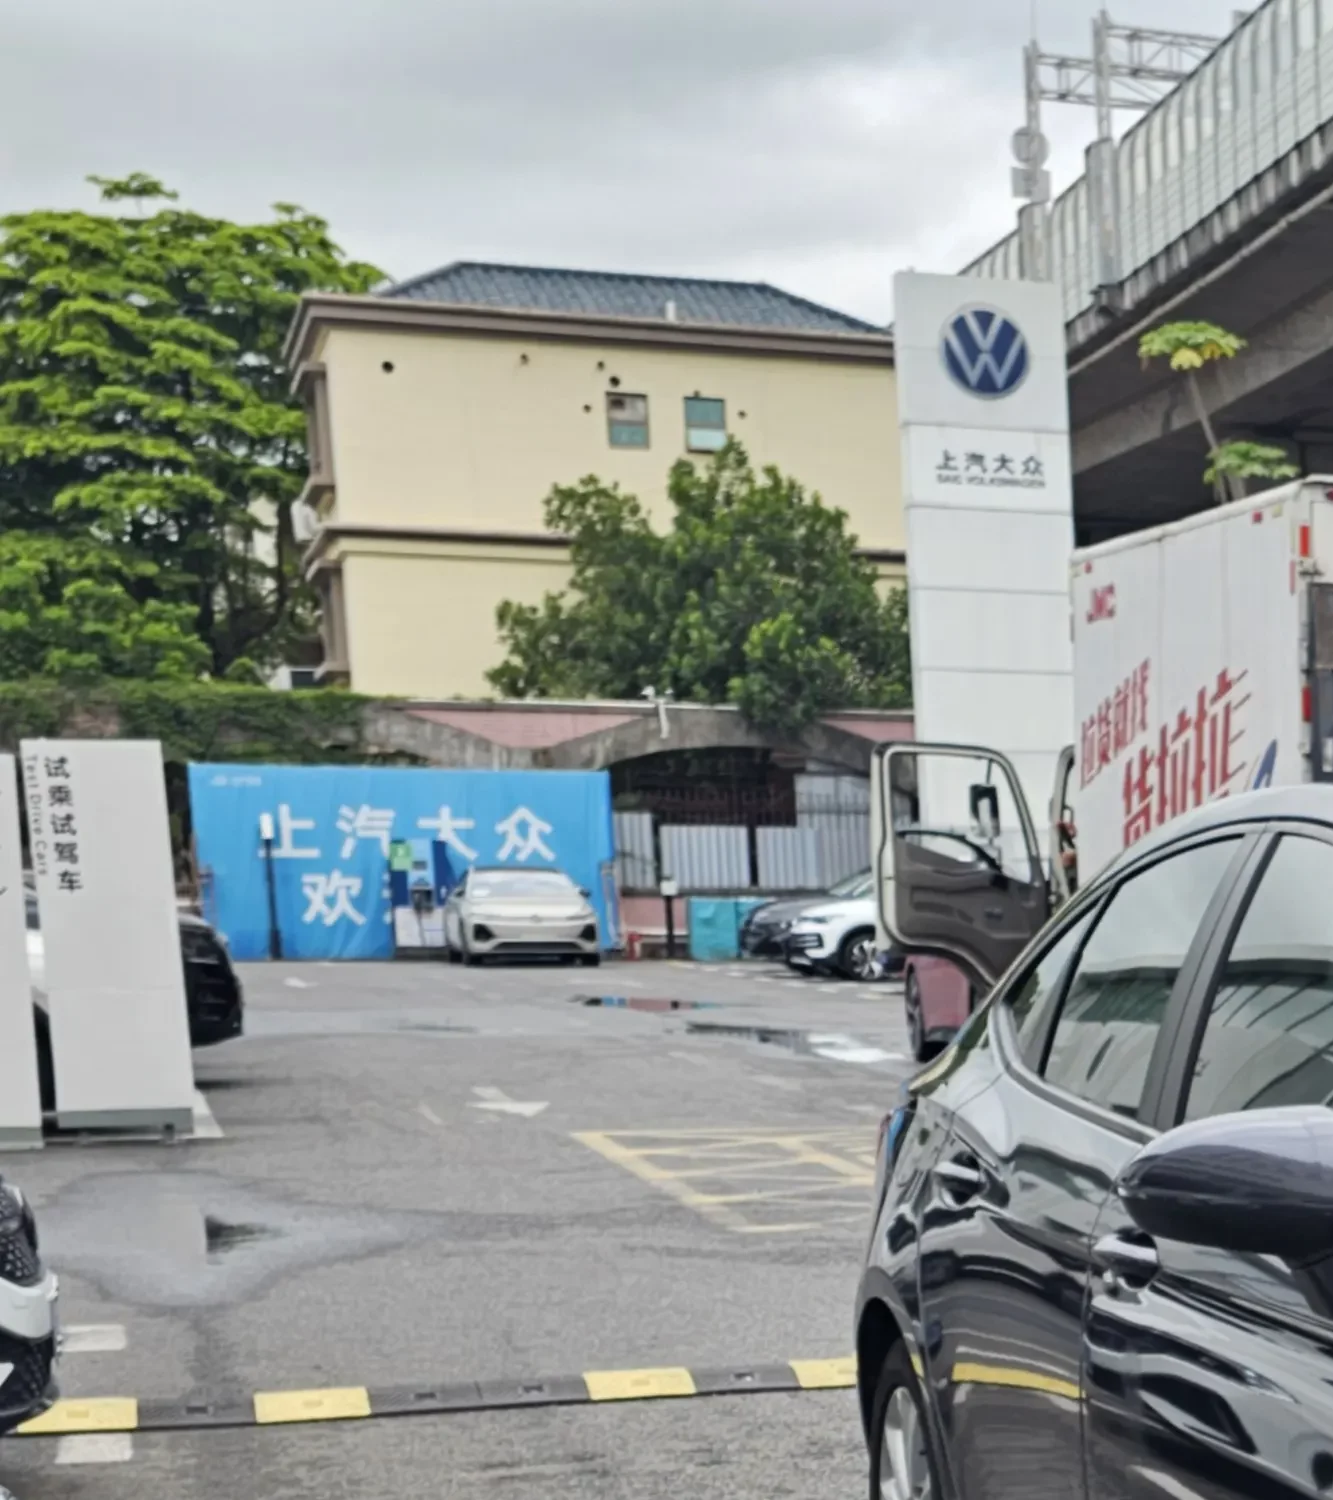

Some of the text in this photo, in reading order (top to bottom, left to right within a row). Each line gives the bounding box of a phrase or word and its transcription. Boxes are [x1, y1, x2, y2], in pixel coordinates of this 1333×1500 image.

[935, 448, 1045, 476] 上汽大众
[43, 755, 84, 894] 试乘试驾车
[258, 802, 556, 863] 上汽大众
[301, 868, 392, 927] 欢
